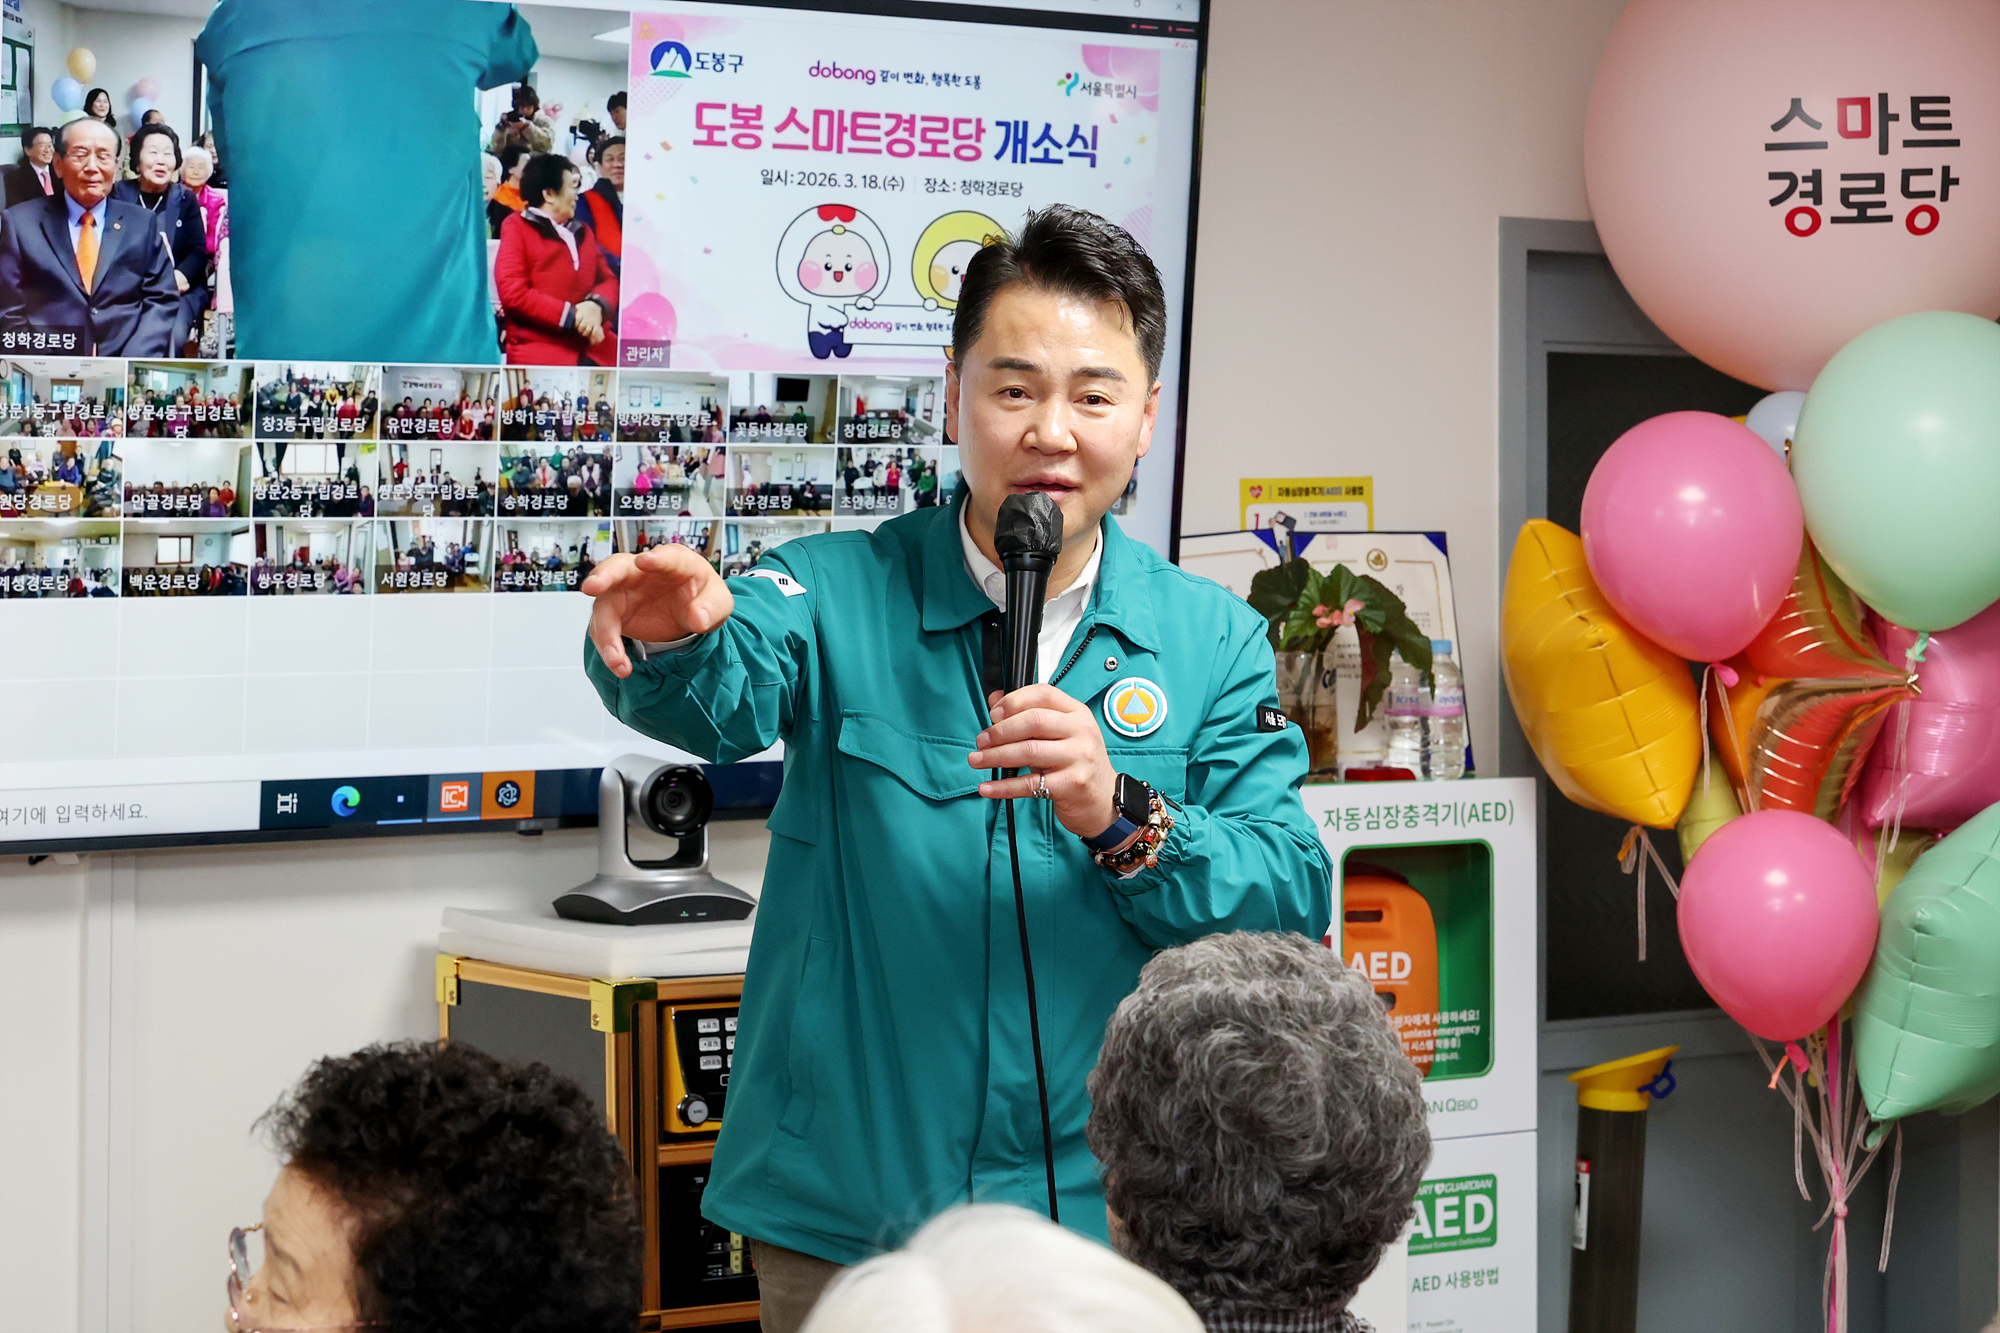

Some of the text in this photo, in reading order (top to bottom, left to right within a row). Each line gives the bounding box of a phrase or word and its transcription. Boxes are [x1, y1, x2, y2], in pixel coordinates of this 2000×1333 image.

[694, 50, 744, 74] 도봉구
[808, 60, 876, 85] dobong
[880, 69, 900, 83] 같이
[931, 72, 961, 87] 행복한
[964, 75, 982, 90] 도봉
[1080, 80, 1138, 100] 서울특별시
[1764, 92, 1960, 155] 스마트
[692, 102, 1099, 169] 도봉 스마트경로당 개소식
[760, 169, 794, 186] 일시:
[797, 171, 841, 188] 2026.
[844, 173, 857, 188] 3.
[923, 177, 1024, 198] 장소: 청학경로당
[1768, 165, 1960, 237] 경로당
[849, 316, 893, 333] dobong
[1, 332, 77, 350] 청학경로당
[625, 346, 664, 363] 관리자
[127, 405, 236, 422] 쌍문4동구립경로
[501, 410, 599, 427] 방학1동구립경로
[618, 412, 712, 428] 방학2동구립경로
[262, 416, 367, 434] 창3동구립경로당
[386, 417, 454, 435] 유만경로당
[843, 423, 903, 439] 창일경로당
[253, 484, 359, 501] 쌍문2동구립경로
[379, 484, 480, 500] 쌍문3동구립경로
[0, 493, 73, 511] 원당경로당
[131, 494, 203, 511] 안골경로당
[504, 494, 569, 511] 송학경로당
[619, 494, 683, 511] 오봉경로당
[732, 494, 792, 510] 신우경로당
[129, 573, 200, 590] 백운경로당
[257, 573, 326, 590] 쌍우경로당
[381, 571, 448, 588] 서원경로당
[500, 570, 578, 587] 도봉산경로당
[0, 803, 148, 826] 여기에 입력하세요.
[1323, 800, 1514, 832] 자동심장충격기(AED)
[1350, 951, 1412, 979] AED
[1408, 1193, 1494, 1241] AED
[1411, 1267, 1499, 1293] AED 사용방법
